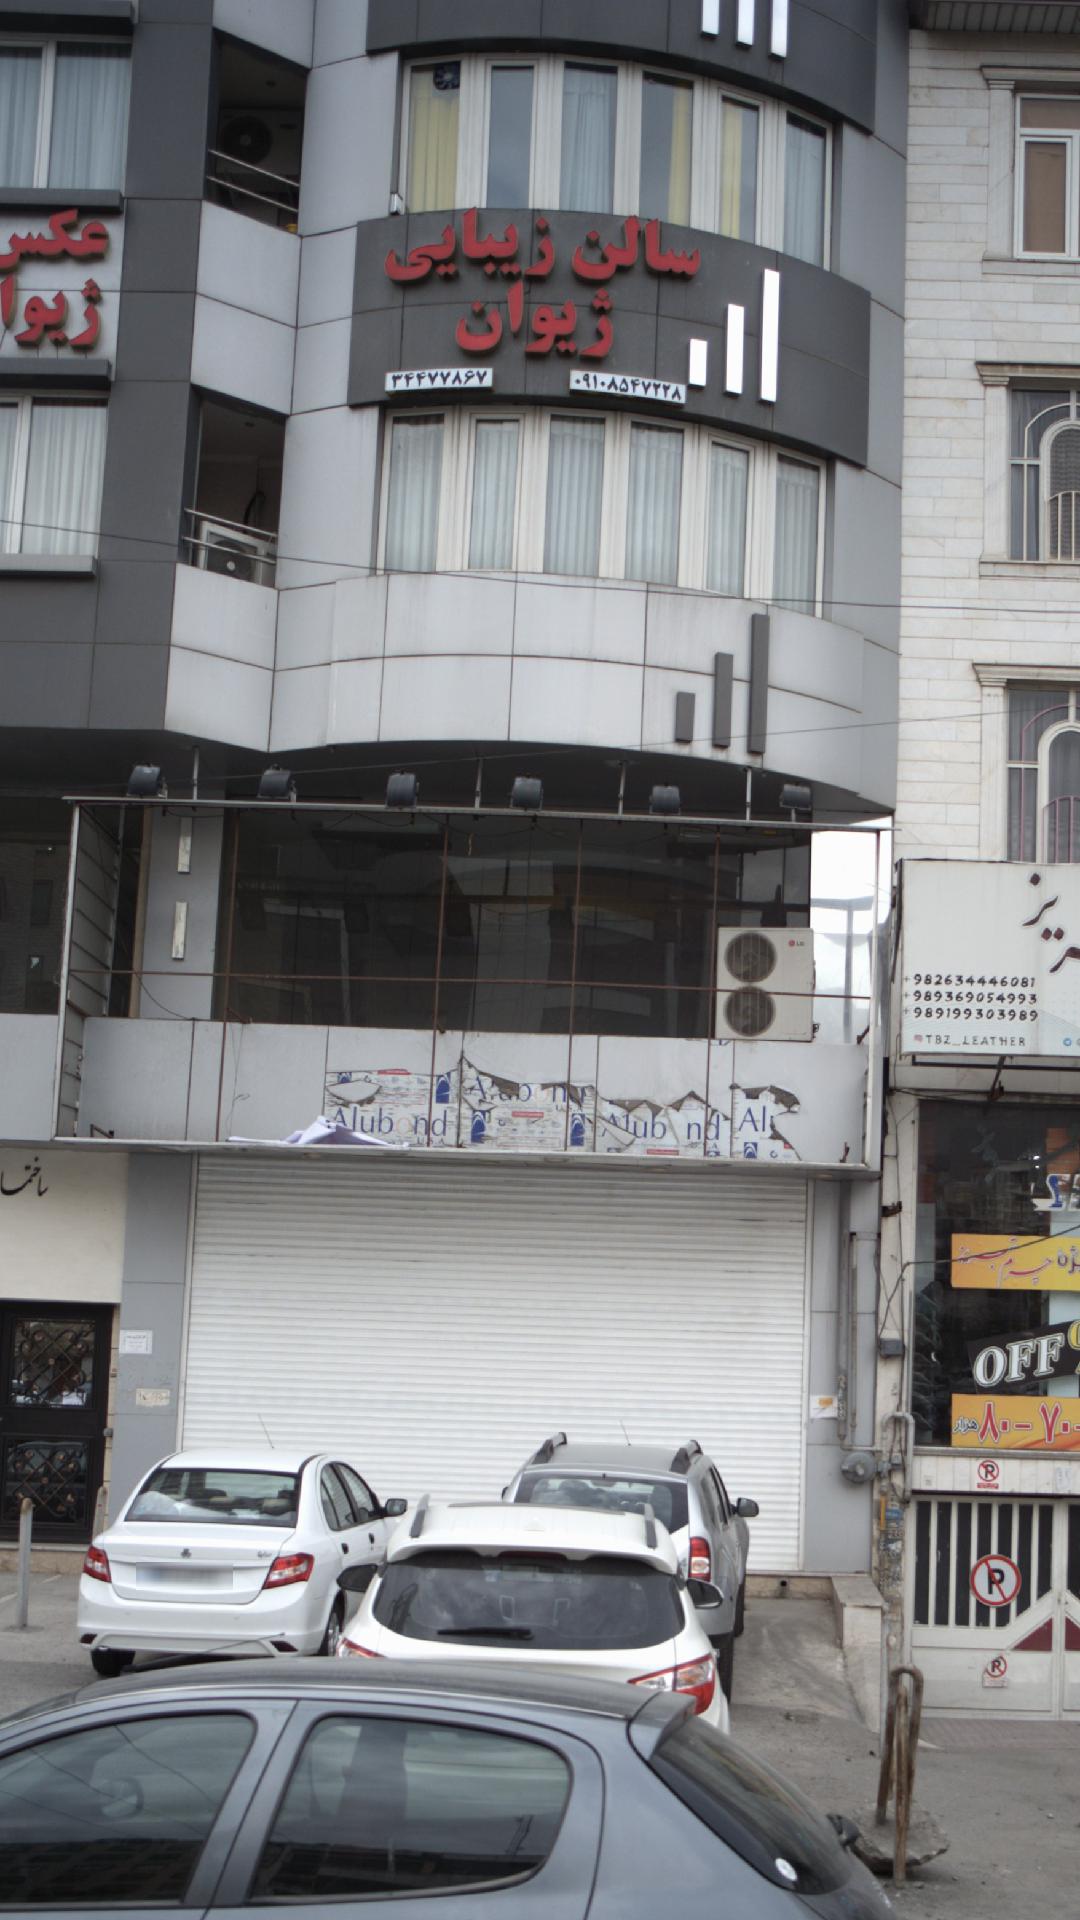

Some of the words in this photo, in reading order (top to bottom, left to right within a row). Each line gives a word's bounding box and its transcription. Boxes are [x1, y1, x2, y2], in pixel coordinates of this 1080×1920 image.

[384, 206, 555, 281] زیبایی
[571, 214, 700, 281] سالن
[455, 279, 613, 357] ژیوان
[973, 1332, 1065, 1387] OFF
